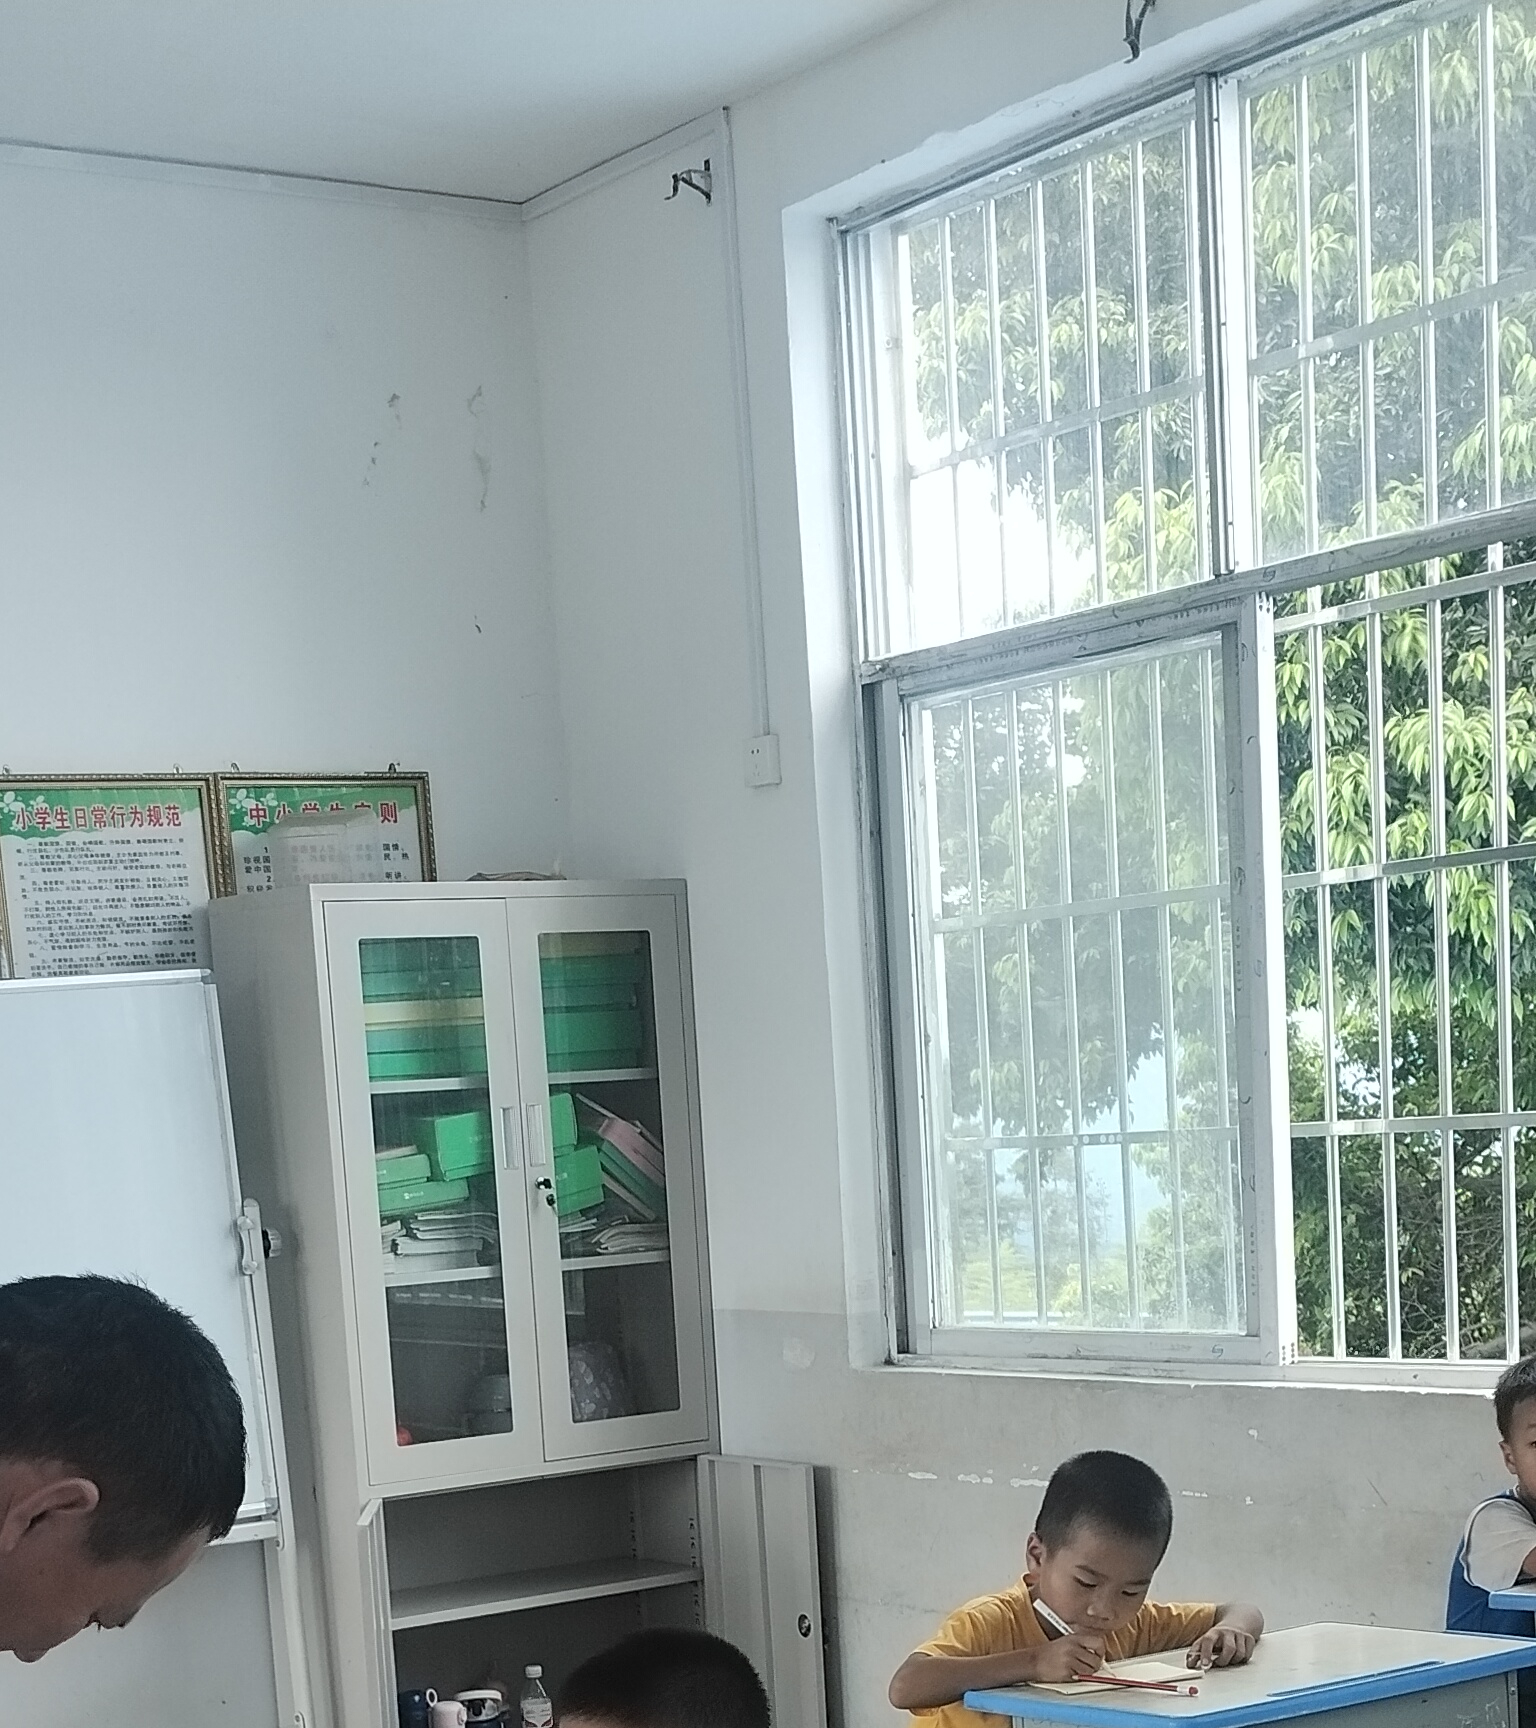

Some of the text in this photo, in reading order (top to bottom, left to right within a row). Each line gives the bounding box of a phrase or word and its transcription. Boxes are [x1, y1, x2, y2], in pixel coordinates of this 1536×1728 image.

[15, 803, 182, 831] 小学生日常行为规范
